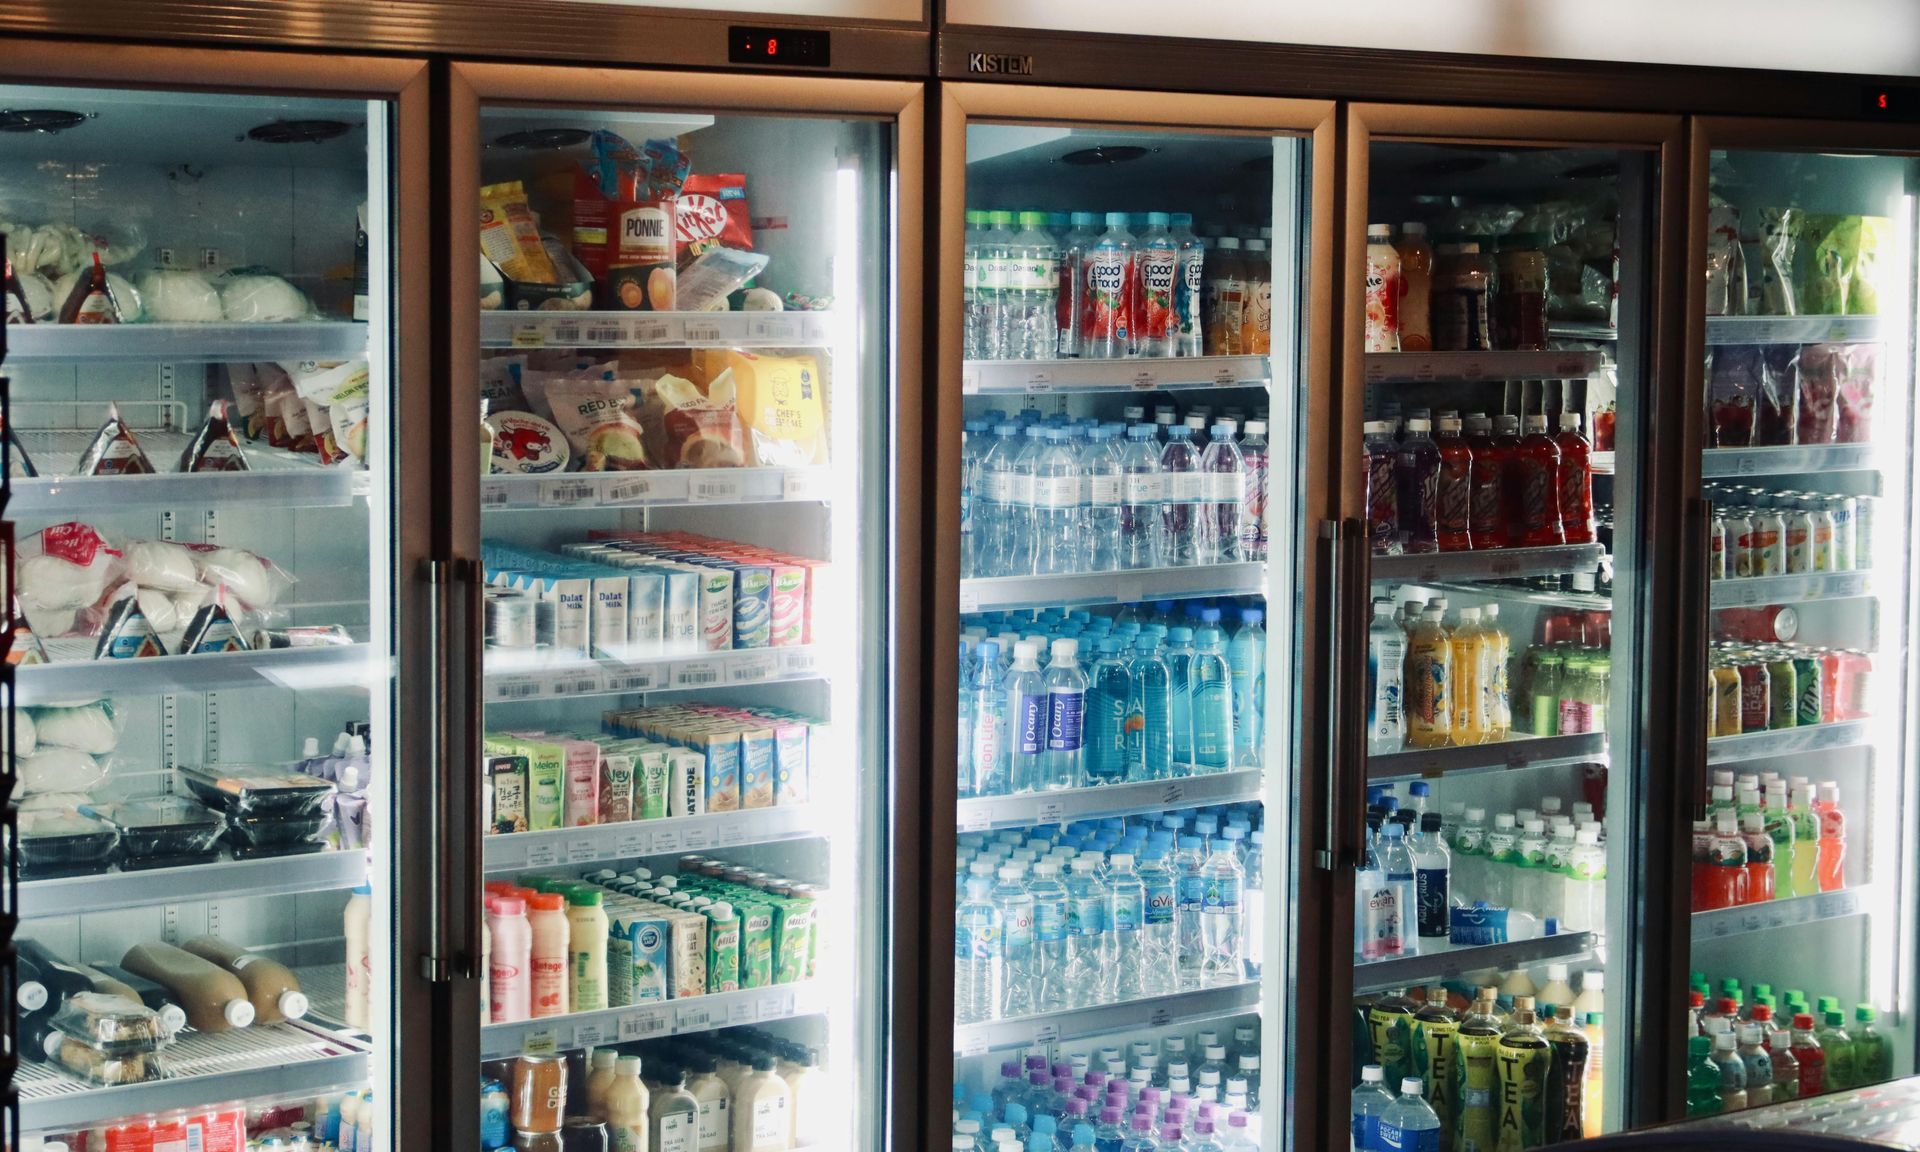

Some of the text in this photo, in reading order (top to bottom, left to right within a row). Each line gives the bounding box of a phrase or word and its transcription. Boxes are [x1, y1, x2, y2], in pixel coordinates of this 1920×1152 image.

[767, 39, 777, 55] 8
[969, 53, 1033, 74] KISTEM
[1092, 264, 1121, 279] good
[1145, 264, 1173, 279] good
[1145, 278, 1171, 288] mood
[577, 399, 606, 416] RED
[560, 594, 584, 603] Dalat
[599, 592, 623, 601] Dalat
[567, 602, 584, 610] Milk
[606, 601, 623, 609] Milk
[1025, 701, 1038, 741] Ocany
[1051, 698, 1065, 738] Ocany
[534, 760, 559, 769] Melon
[686, 767, 696, 816] ATSIDE
[748, 919, 769, 930] MILO
[788, 918, 807, 928] MILO
[1017, 916, 1033, 928] laV
[1431, 1033, 1449, 1105] TEA
[1501, 1056, 1520, 1131] TEA
[1563, 1061, 1583, 1130] TEA
